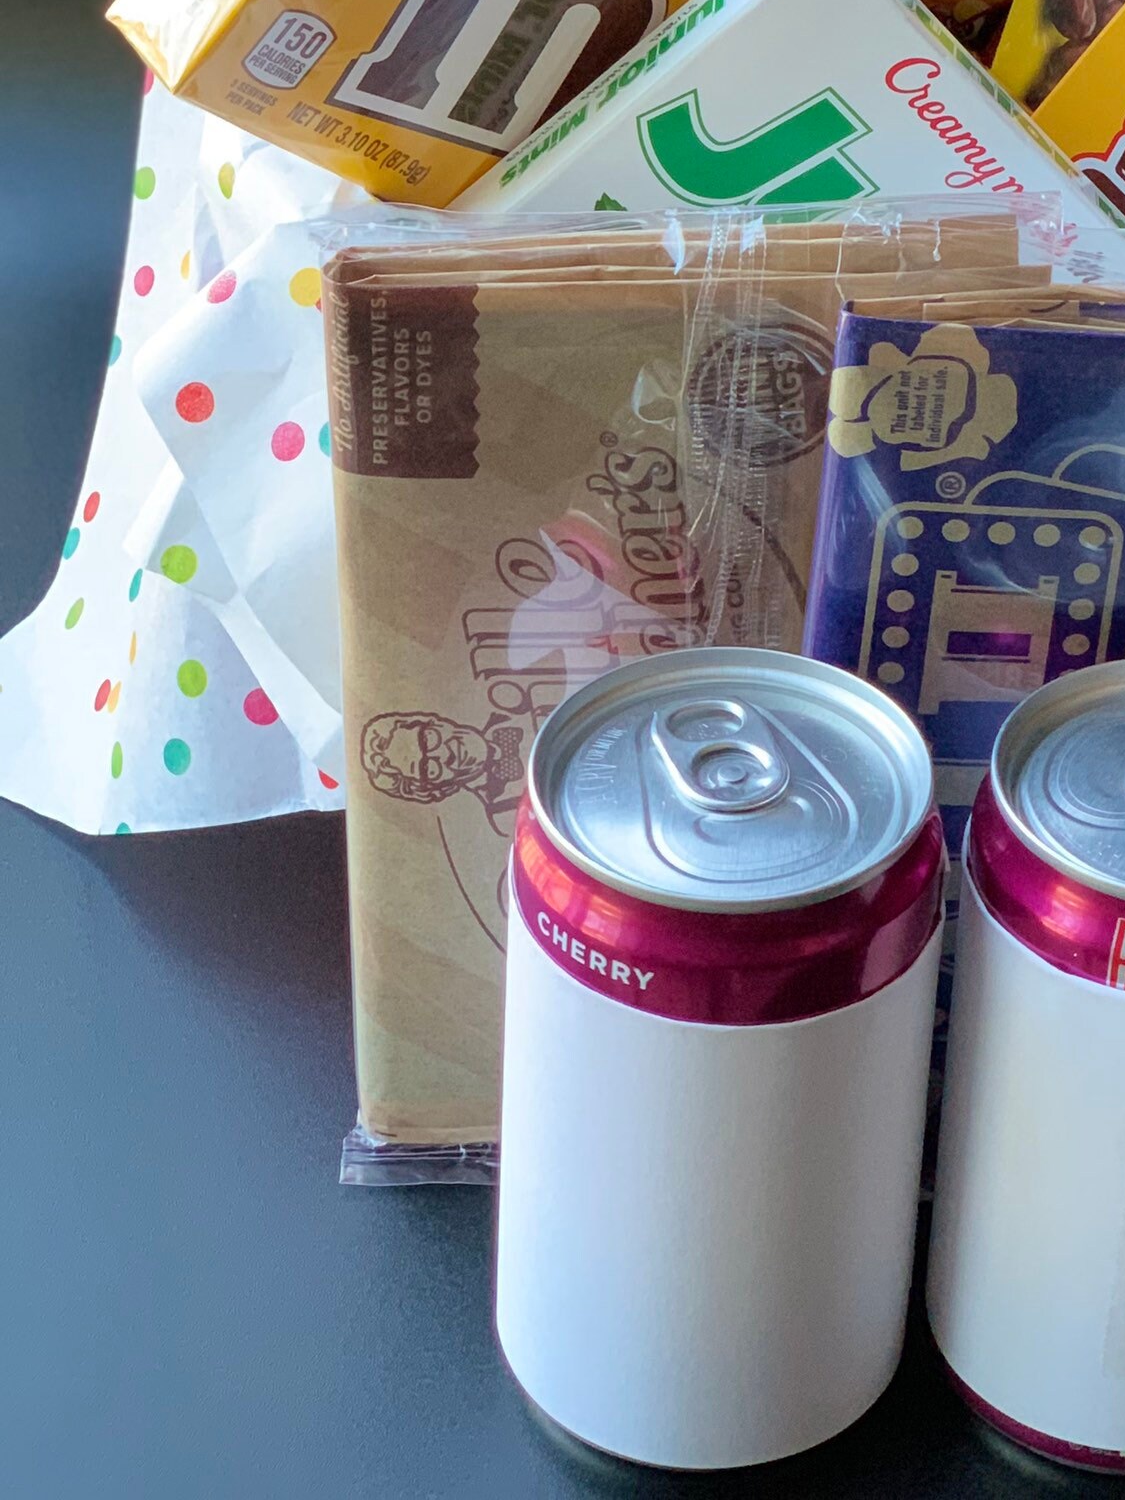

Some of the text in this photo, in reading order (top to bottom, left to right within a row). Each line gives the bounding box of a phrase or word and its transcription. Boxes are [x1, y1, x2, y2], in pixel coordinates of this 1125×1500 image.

[249, 54, 298, 85] PER SERVING
[257, 44, 306, 75] CALORIES
[274, 17, 327, 59] 150
[225, 91, 267, 116] PER PACK
[237, 83, 278, 107] SERVINGS
[884, 57, 1004, 190] Creamy
[287, 101, 432, 186] NET WT 3.10 OZ (87.9g)
[499, 103, 588, 188] Mints
[328, 291, 360, 412] Artificial
[370, 289, 390, 465] PRESERVATIVES,
[394, 327, 411, 426] FLAVORS
[416, 330, 432, 424] OR DYES
[890, 370, 912, 434] This unit not
[910, 376, 929, 432] labeled for
[926, 366, 949, 444] individual sale.
[537, 911, 655, 991] CHERRY
